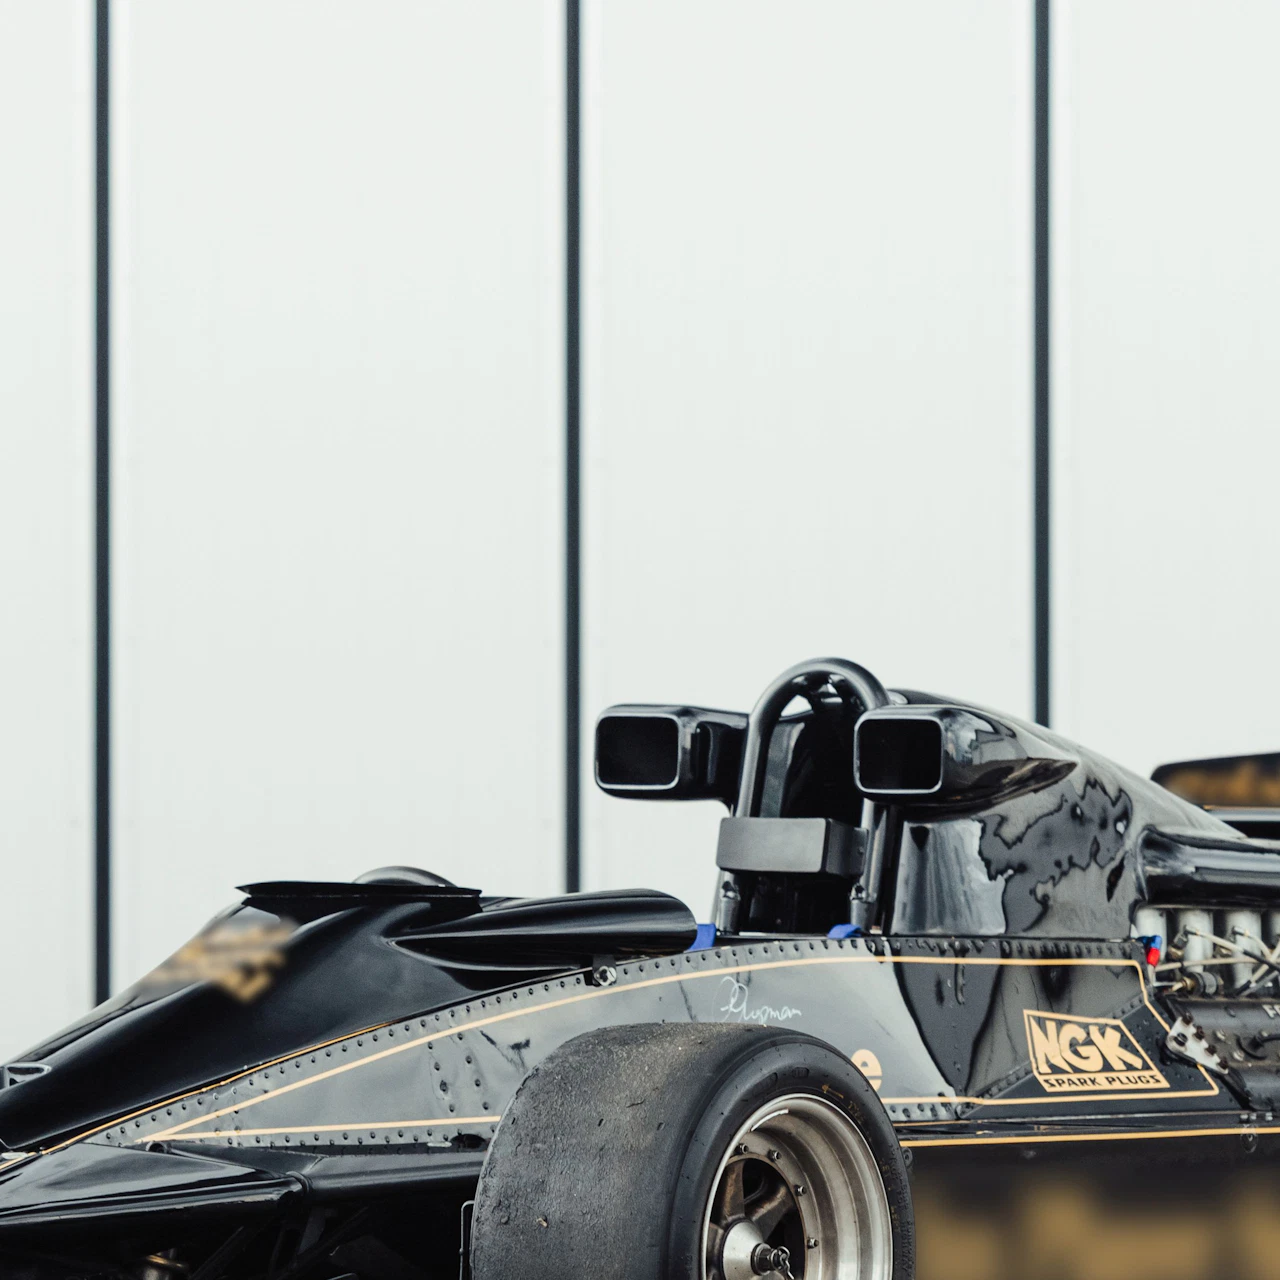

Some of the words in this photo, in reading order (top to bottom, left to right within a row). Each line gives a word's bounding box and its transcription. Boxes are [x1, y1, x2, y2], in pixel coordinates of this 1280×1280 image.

[1028, 1014, 1144, 1075] NGK
[1043, 1076, 1104, 1089] SPARK
[1104, 1073, 1162, 1087] PLUGS
